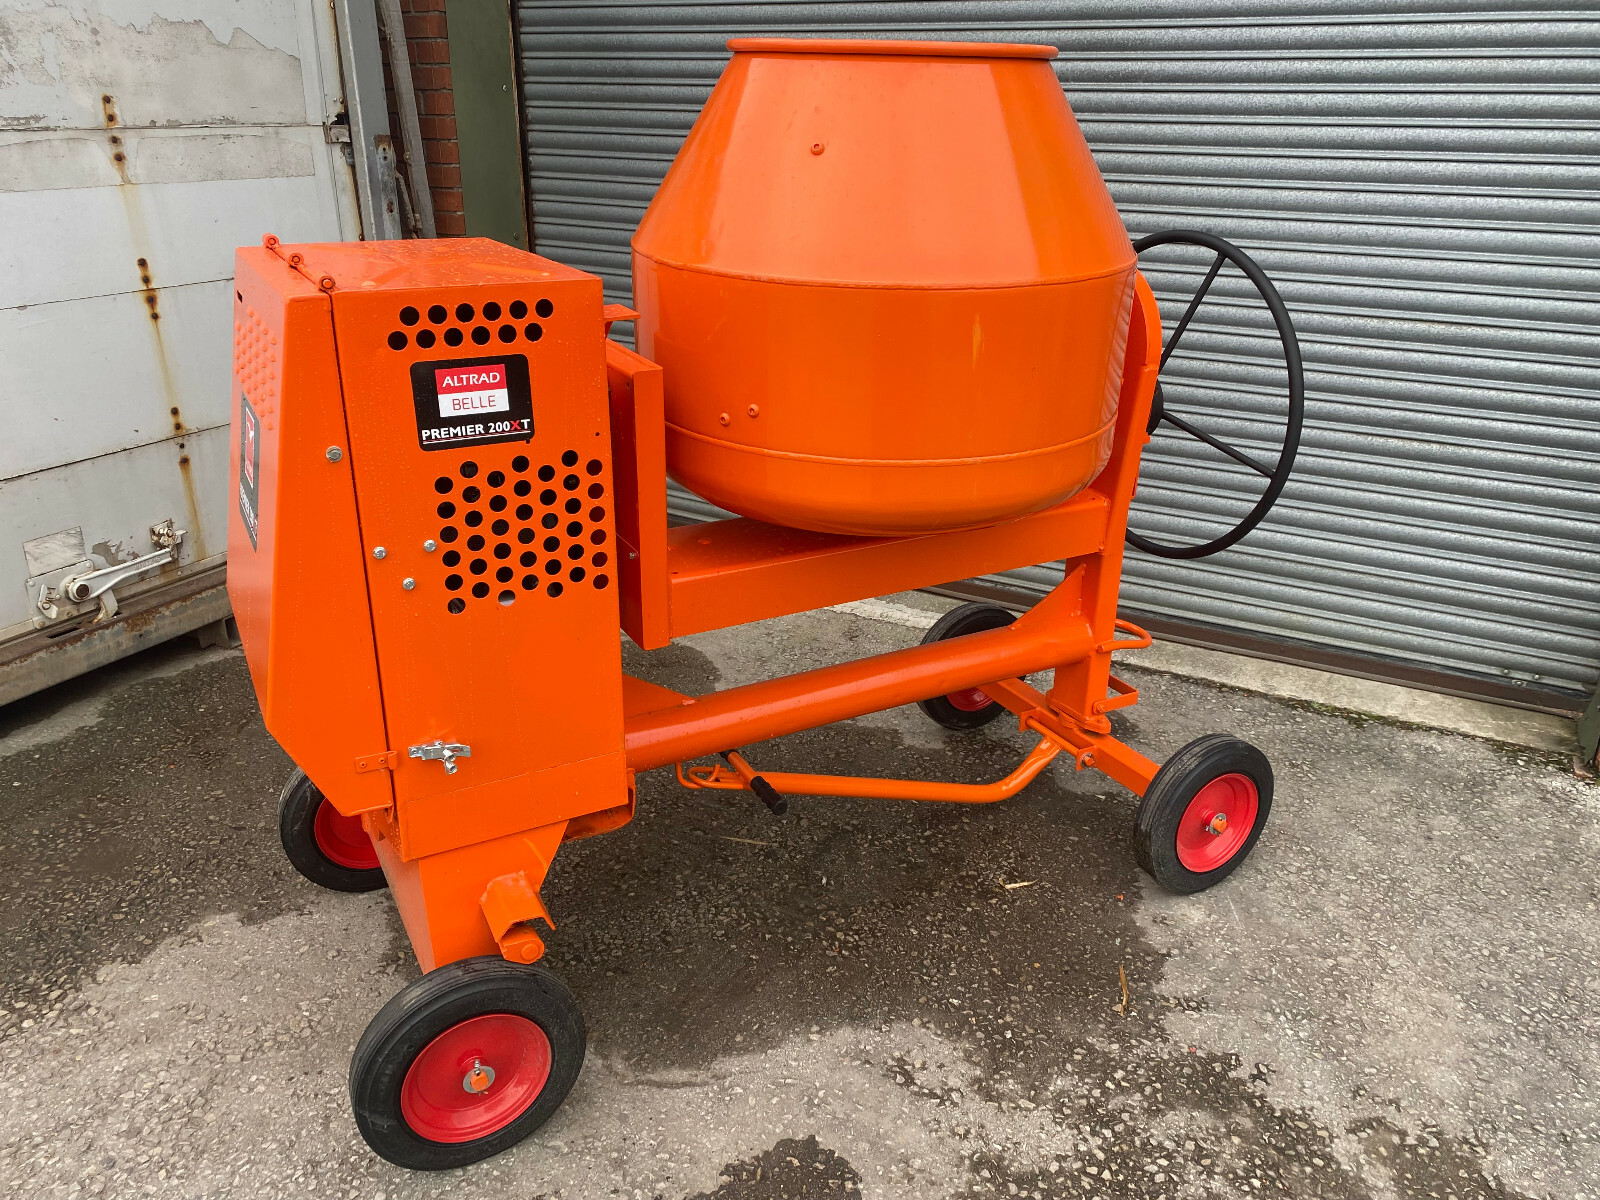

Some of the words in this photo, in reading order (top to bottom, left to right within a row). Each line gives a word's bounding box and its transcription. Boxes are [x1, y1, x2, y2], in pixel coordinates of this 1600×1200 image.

[442, 372, 500, 388] ALTRAD
[452, 395, 497, 411] BELLE
[421, 423, 485, 441] PREMIER
[487, 419, 531, 434] 200XT
